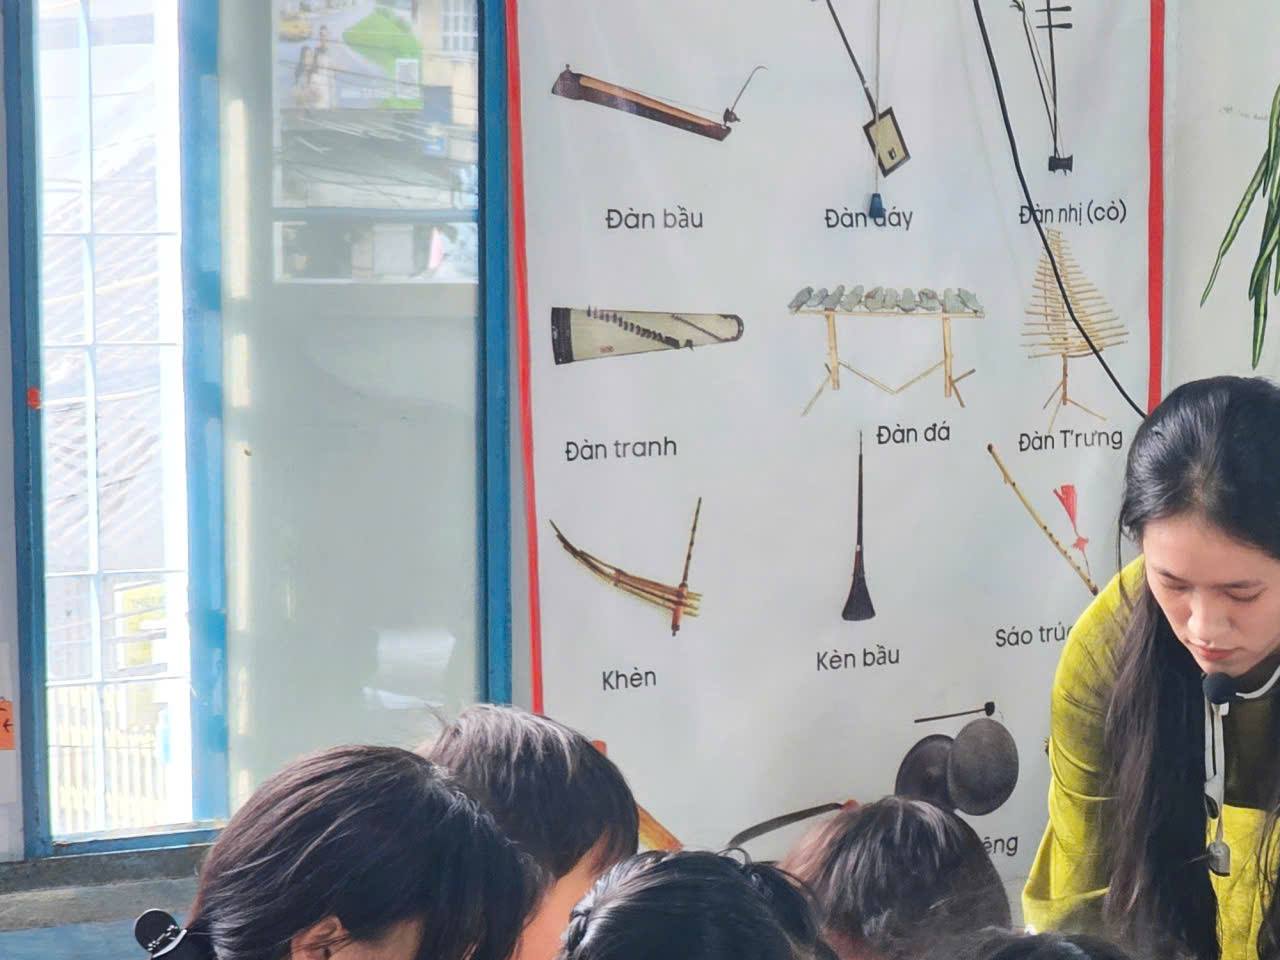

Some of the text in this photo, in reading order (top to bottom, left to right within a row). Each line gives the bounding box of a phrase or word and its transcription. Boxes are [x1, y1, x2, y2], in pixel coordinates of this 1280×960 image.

[605, 205, 703, 229] Đàn bầu
[824, 206, 867, 228] Đàn
[1018, 199, 1127, 226] Đàn nhị (cò)
[876, 420, 951, 445] Đàn đá
[1018, 431, 1055, 452] Đàn
[565, 436, 677, 461] Đàn tranh
[995, 626, 1033, 647] Sáo
[816, 644, 900, 672] Kèn bầu
[602, 667, 657, 691] Khèn
